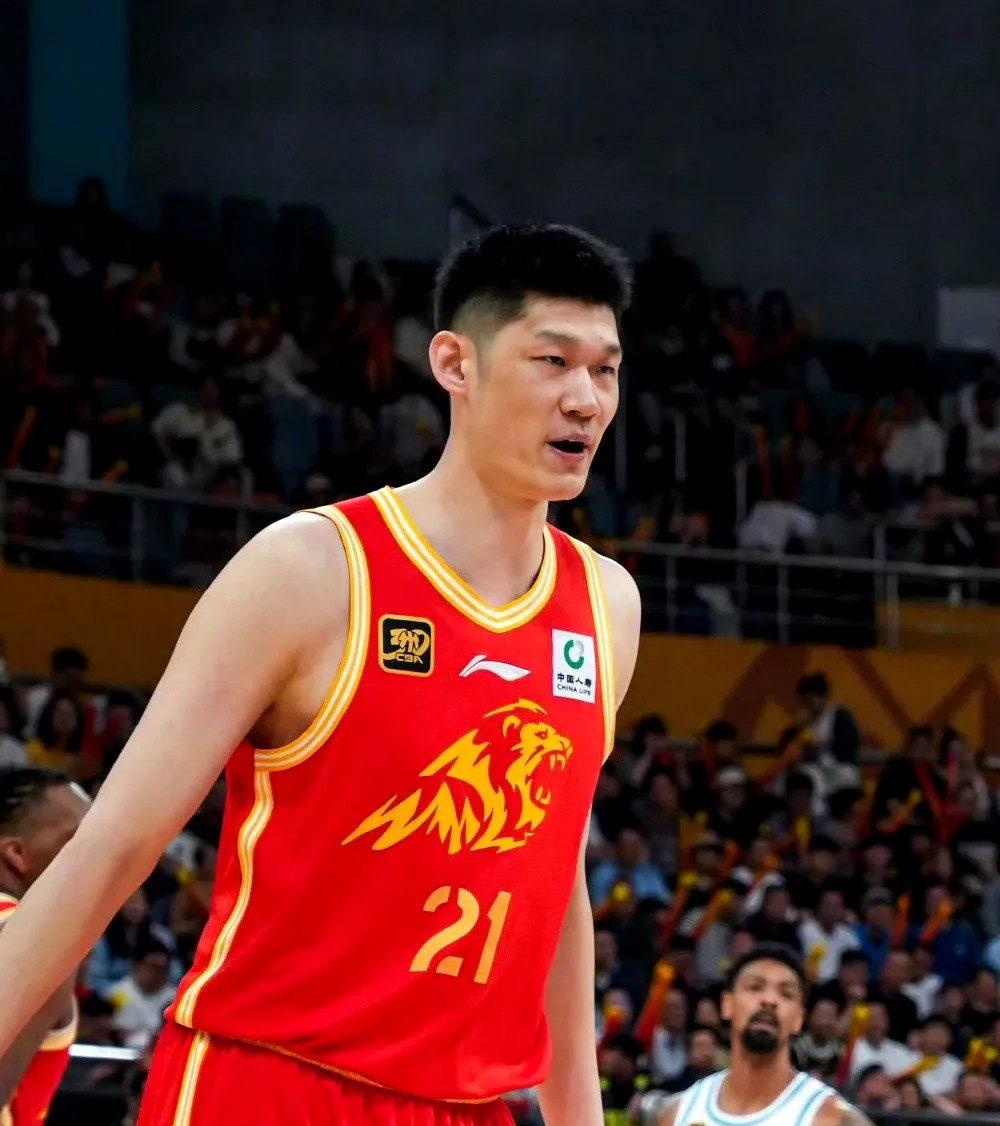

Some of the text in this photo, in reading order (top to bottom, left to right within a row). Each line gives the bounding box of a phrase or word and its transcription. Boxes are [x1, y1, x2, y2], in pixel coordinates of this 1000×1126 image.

[396, 653, 424, 664] CBA
[557, 673, 592, 688] 中国人寿
[557, 684, 592, 696] CHINA LIFE
[409, 886, 512, 984] 21
